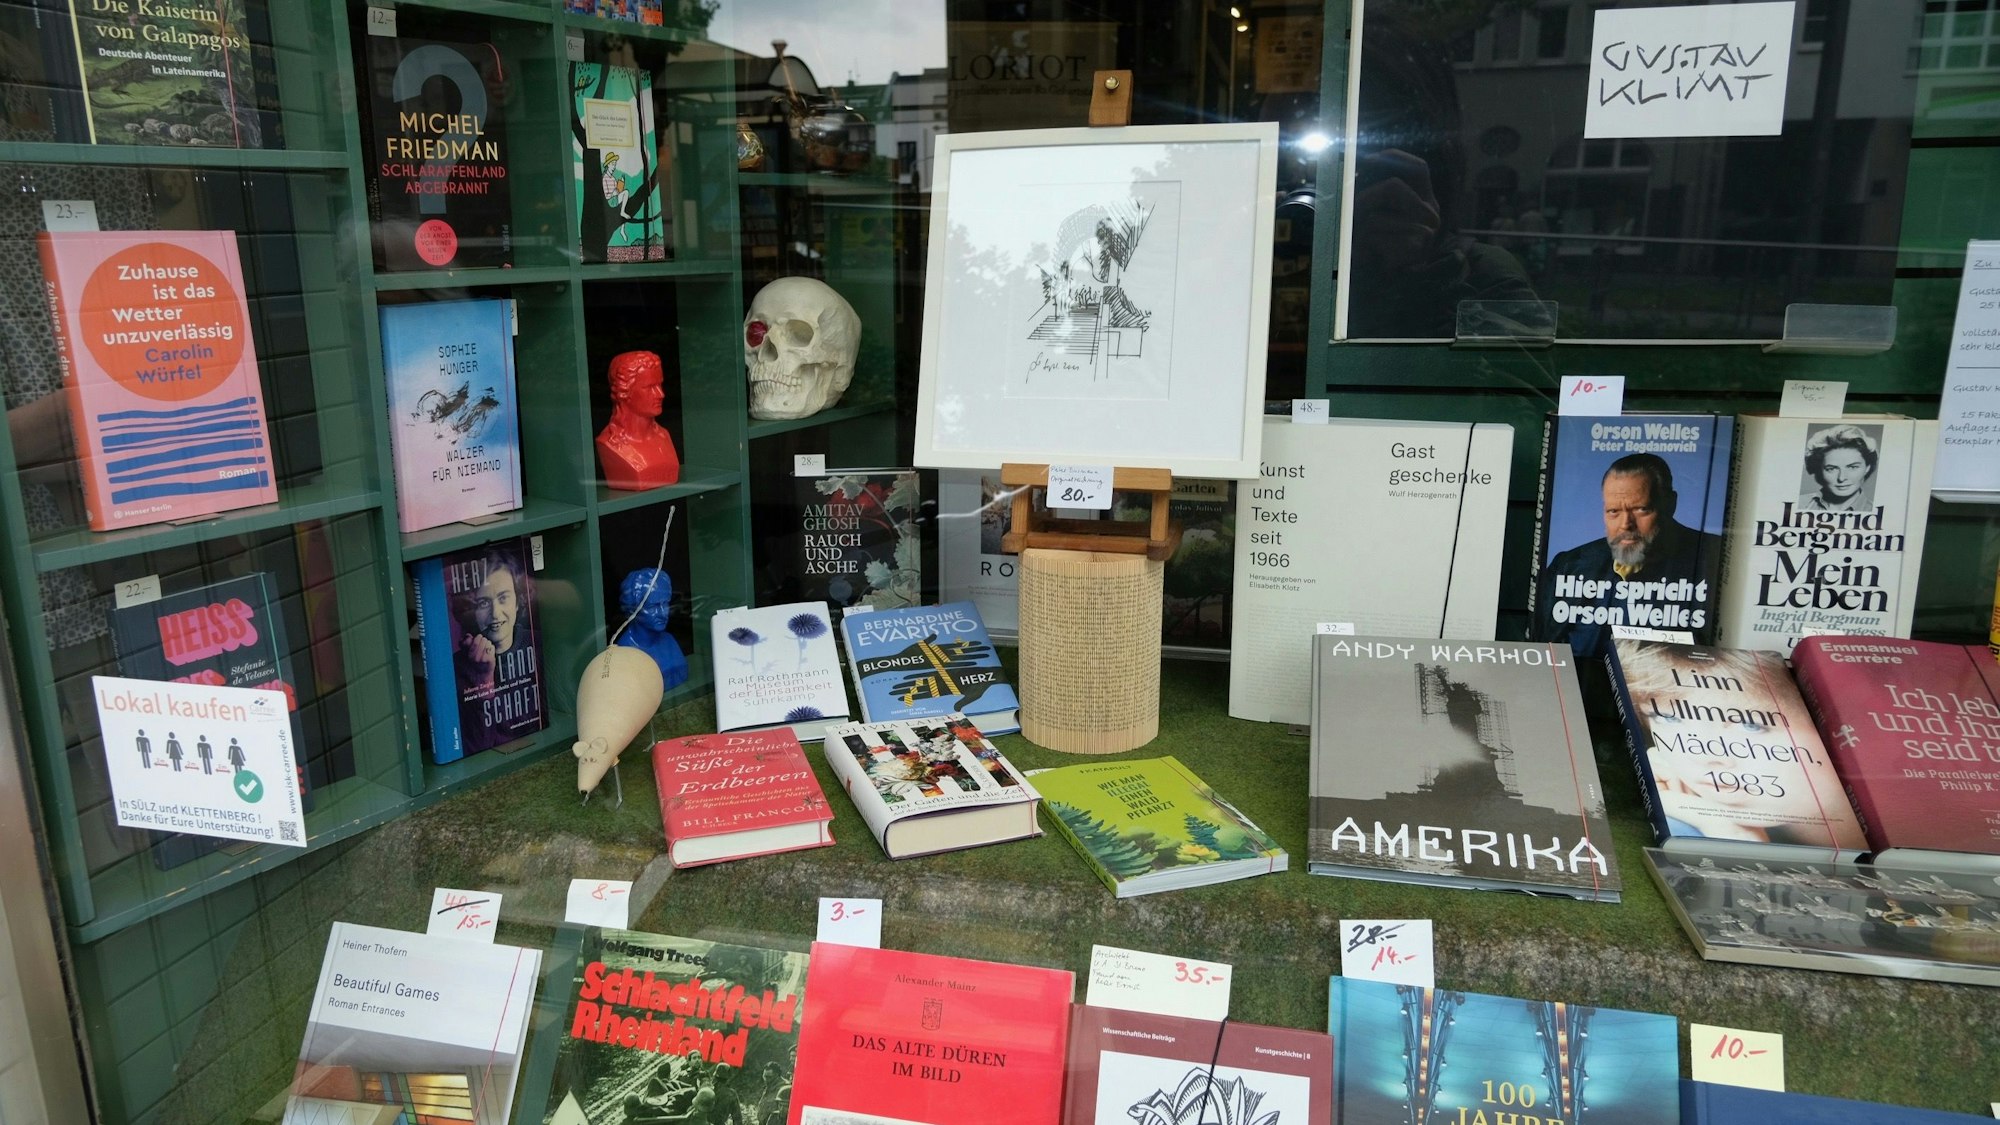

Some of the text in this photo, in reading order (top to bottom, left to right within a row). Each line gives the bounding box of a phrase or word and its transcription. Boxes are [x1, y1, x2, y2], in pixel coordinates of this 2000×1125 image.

[93, 0, 218, 22] Die Kaiserin
[96, 25, 240, 50] von Galapagos
[99, 48, 192, 64] Deutsche Abenteuer
[152, 65, 226, 79] in Lateinamerika
[948, 54, 1086, 81] LORIOT
[1600, 71, 1773, 107] KLIMT
[400, 111, 485, 136] MICHEL
[386, 137, 499, 161] FRIEDMAN
[381, 163, 506, 178] SCHLARAFFENLAND
[405, 182, 490, 195] ABGEBRANNT
[118, 263, 199, 281] Zuhause
[153, 283, 215, 300] ist das
[46, 280, 60, 333] Zuhause
[112, 306, 183, 323] Wetter
[103, 323, 233, 347] unzuverlässig
[145, 345, 213, 363] Carolin
[438, 343, 477, 358] SOPHIE
[136, 364, 202, 384] Würfel
[440, 360, 479, 376] HUNGER
[1571, 379, 1607, 397] 10.-
[1953, 384, 1991, 393] Gustav
[1591, 423, 1700, 441] Orson Welles
[446, 445, 485, 463] WALZER
[1391, 442, 1435, 459] Gast
[1591, 440, 1697, 454] Peter Bogdanovich
[219, 466, 256, 480] Roman
[432, 459, 501, 483] FÜR NIEMAND
[1260, 462, 1305, 479] Kunst
[1389, 467, 1492, 486] geschenke
[1061, 487, 1094, 502] 80.-
[1252, 486, 1285, 501] und
[1389, 490, 1457, 501] Wulf Herzogenrath
[124, 503, 172, 518] Hanser Berlin
[803, 503, 865, 518] AMITAV
[1251, 507, 1298, 524] Texte
[1781, 502, 1885, 535] Ingrid
[803, 517, 860, 531] GHOSH
[804, 534, 862, 548] RAUCH
[1251, 532, 1282, 546] seit
[1754, 520, 1905, 555] Bergman
[805, 548, 842, 561] UND
[1249, 552, 1290, 568] 1966
[450, 557, 490, 594] HERZ
[805, 560, 859, 575] ASCHE
[1772, 550, 1880, 587] Mein
[1249, 574, 1301, 584] Herausgegeben
[1249, 582, 1300, 592] Elisabeth Klotz
[1555, 575, 1708, 604] Hier spricht
[1756, 573, 1889, 612] Leben
[863, 610, 964, 631] BERNARDINE
[1552, 601, 1705, 628] Orson Welles
[1760, 608, 1880, 627] Ingrid Bergman
[157, 598, 258, 665] HEISS
[857, 618, 978, 647] EVARISTO
[1619, 627, 1646, 637] NEU!
[1753, 621, 1784, 633] und
[1332, 640, 1567, 668] ANDY WARHOL
[1819, 642, 1918, 656] Emmanuel
[1832, 652, 1903, 664] Carrère
[231, 659, 266, 676] Stefanie
[499, 646, 536, 683] LAND
[862, 654, 925, 672] BLONDES
[233, 675, 243, 686] de
[244, 667, 275, 684] Velasco
[728, 669, 829, 687] Ralf Rothmann
[745, 677, 804, 691] Museum
[960, 671, 996, 686] HERZ
[1671, 668, 1744, 692] Linn
[728, 680, 832, 700] der Einsamkeit
[1884, 684, 1949, 713] Ich
[101, 689, 163, 715] Lokal
[169, 693, 248, 722] kaufen
[483, 683, 540, 728] SCHAFT
[743, 692, 816, 708] Suhrkamp
[1650, 697, 1790, 728] Ullmann
[838, 721, 897, 736] OLIVIA
[1868, 711, 1953, 736] und
[725, 736, 763, 747] Die
[1651, 731, 1824, 767] Mädchen,
[1903, 738, 1979, 763] seid
[666, 741, 797, 763] unwahrscheinliche
[278, 729, 297, 814] www.isk-carree.de
[674, 757, 735, 775] Süße
[731, 763, 766, 775] der
[1903, 768, 1925, 780] Die
[678, 771, 809, 795] Erdbeeren
[1098, 774, 1145, 792] WIE MAN
[1108, 781, 1150, 797] ILLEGAL
[1705, 770, 1787, 798] 1983
[1940, 780, 1999, 793] Philip K.
[889, 802, 911, 813] Der
[914, 794, 960, 808] Garten
[958, 791, 980, 800] und
[981, 789, 1000, 798] die
[1119, 789, 1153, 804] EINEN
[1127, 796, 1158, 810] WALD
[119, 799, 256, 824] In SÜLZ und KLETTENBERG
[683, 803, 823, 828] BILL FRANÇOIS
[1126, 800, 1176, 821] PFLANZT
[121, 811, 274, 840] Danke für Eure Unterstützung!
[1331, 816, 1608, 876] AMERIKA
[830, 902, 865, 921] 3.-
[343, 939, 408, 957] Heiner Thofern
[593, 935, 710, 967] Wolfgang Trees
[1372, 946, 1416, 971] 14.-
[1175, 961, 1224, 985] 35.-
[334, 974, 440, 1002] Beautiful Games
[894, 973, 977, 993] Alexander Mainz
[579, 961, 797, 1034] Schlachtfeld
[328, 997, 406, 1018] Roman Entrances
[571, 1001, 749, 1068] Rheinland
[1102, 1026, 1176, 1043] Wissenschaftliche Beiträge
[852, 1034, 1006, 1068] DAS ALTE DÜREN
[1255, 1046, 1303, 1060] Kunstgeschichte
[1711, 1034, 1768, 1060] 10.-
[892, 1061, 961, 1084] IM BILD
[1482, 1079, 1537, 1108] 100
[1450, 1106, 1565, 1125] JAH
